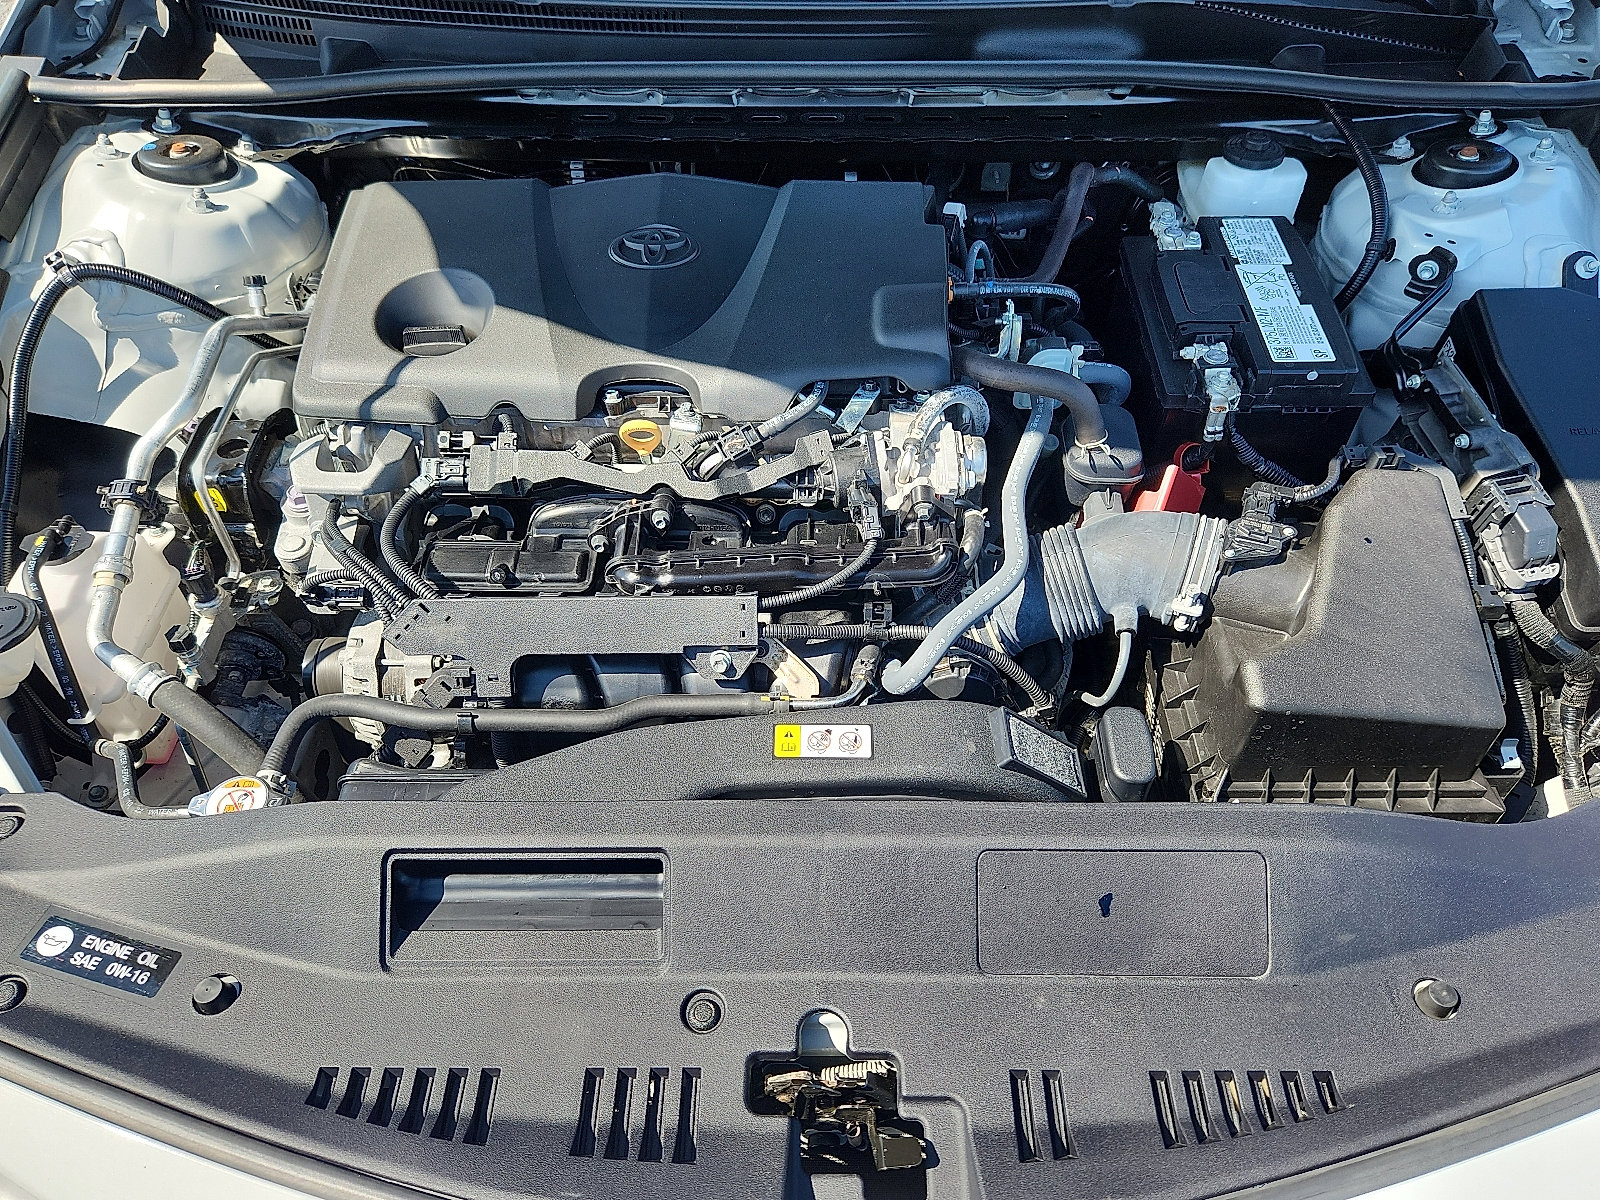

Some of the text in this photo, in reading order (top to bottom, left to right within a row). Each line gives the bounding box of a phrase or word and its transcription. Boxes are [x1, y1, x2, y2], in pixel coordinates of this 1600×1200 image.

[1313, 349, 1328, 358] SP
[45, 621, 56, 645] WATER
[81, 934, 160, 970] ENGINE OIL
[69, 951, 151, 985] SAE 0W-16
